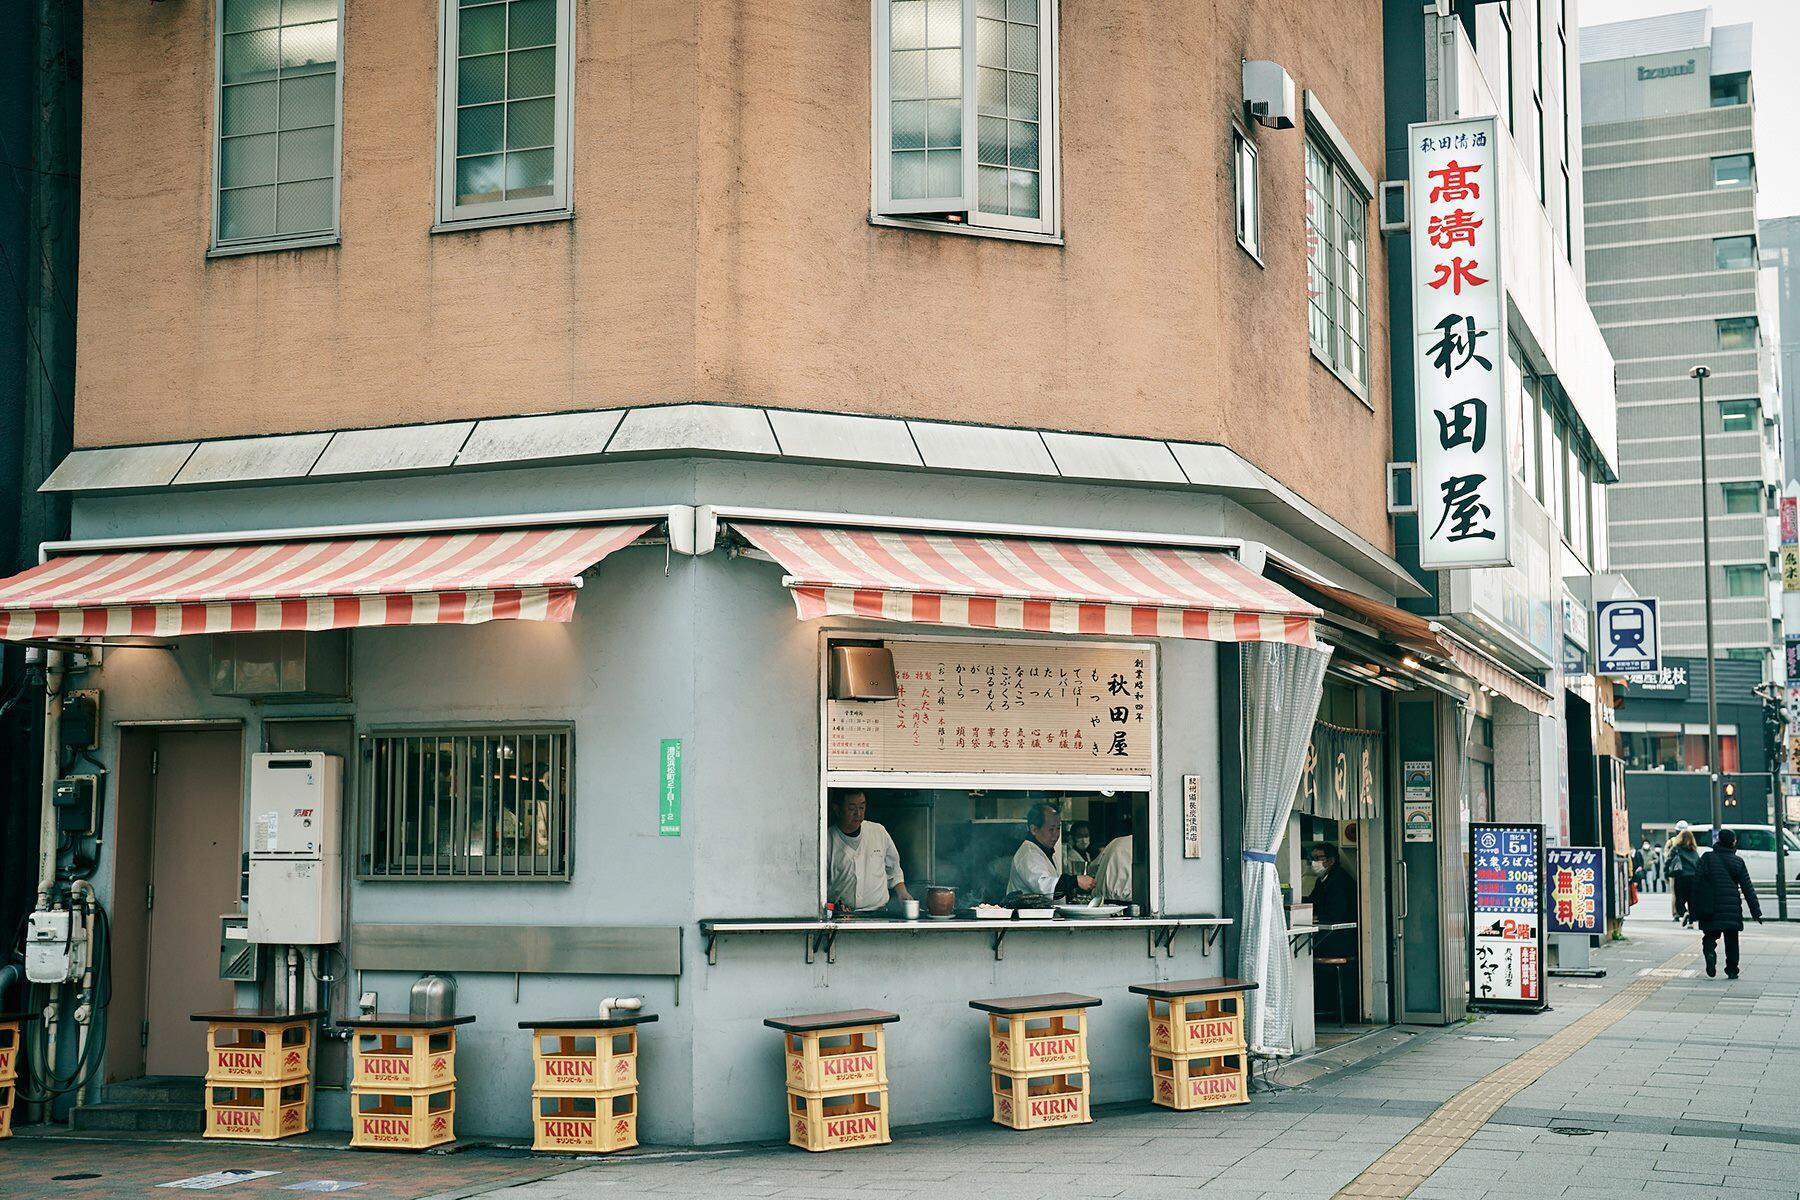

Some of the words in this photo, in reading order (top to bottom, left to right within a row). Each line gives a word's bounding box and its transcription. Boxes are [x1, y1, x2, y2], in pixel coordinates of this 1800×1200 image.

[1638, 59, 1695, 81] izumi
[1420, 132, 1487, 153] 秋田清酒
[1425, 313, 1496, 542] 秋田屋
[956, 664, 966, 699] かしら
[970, 665, 980, 694] がつ
[1014, 666, 1024, 706] なんこつ
[1030, 668, 1040, 696] はつ
[1044, 667, 1054, 698] たん
[1059, 668, 1068, 697] レバー
[1090, 668, 1100, 756] もつやき
[1107, 673, 1130, 756] 秋田屋
[1548, 850, 1596, 864] カラオケ
[1558, 870, 1572, 923] 無料
[1504, 919, 1530, 940] 2階
[1190, 1022, 1233, 1039] KIRIN
[1029, 1038, 1076, 1058] KIRIN
[218, 1052, 262, 1068] KIRIN
[364, 1059, 410, 1074] KIRIN
[546, 1060, 592, 1076] KIRIN
[824, 1056, 873, 1076] KIRIN
[1192, 1078, 1236, 1096] KIRIN
[1032, 1098, 1078, 1116] KIRIN
[216, 1110, 260, 1126] KIRIN
[363, 1119, 409, 1135] KIRIN
[827, 1117, 877, 1137] KIRIN
[545, 1122, 592, 1138] KIRIN
